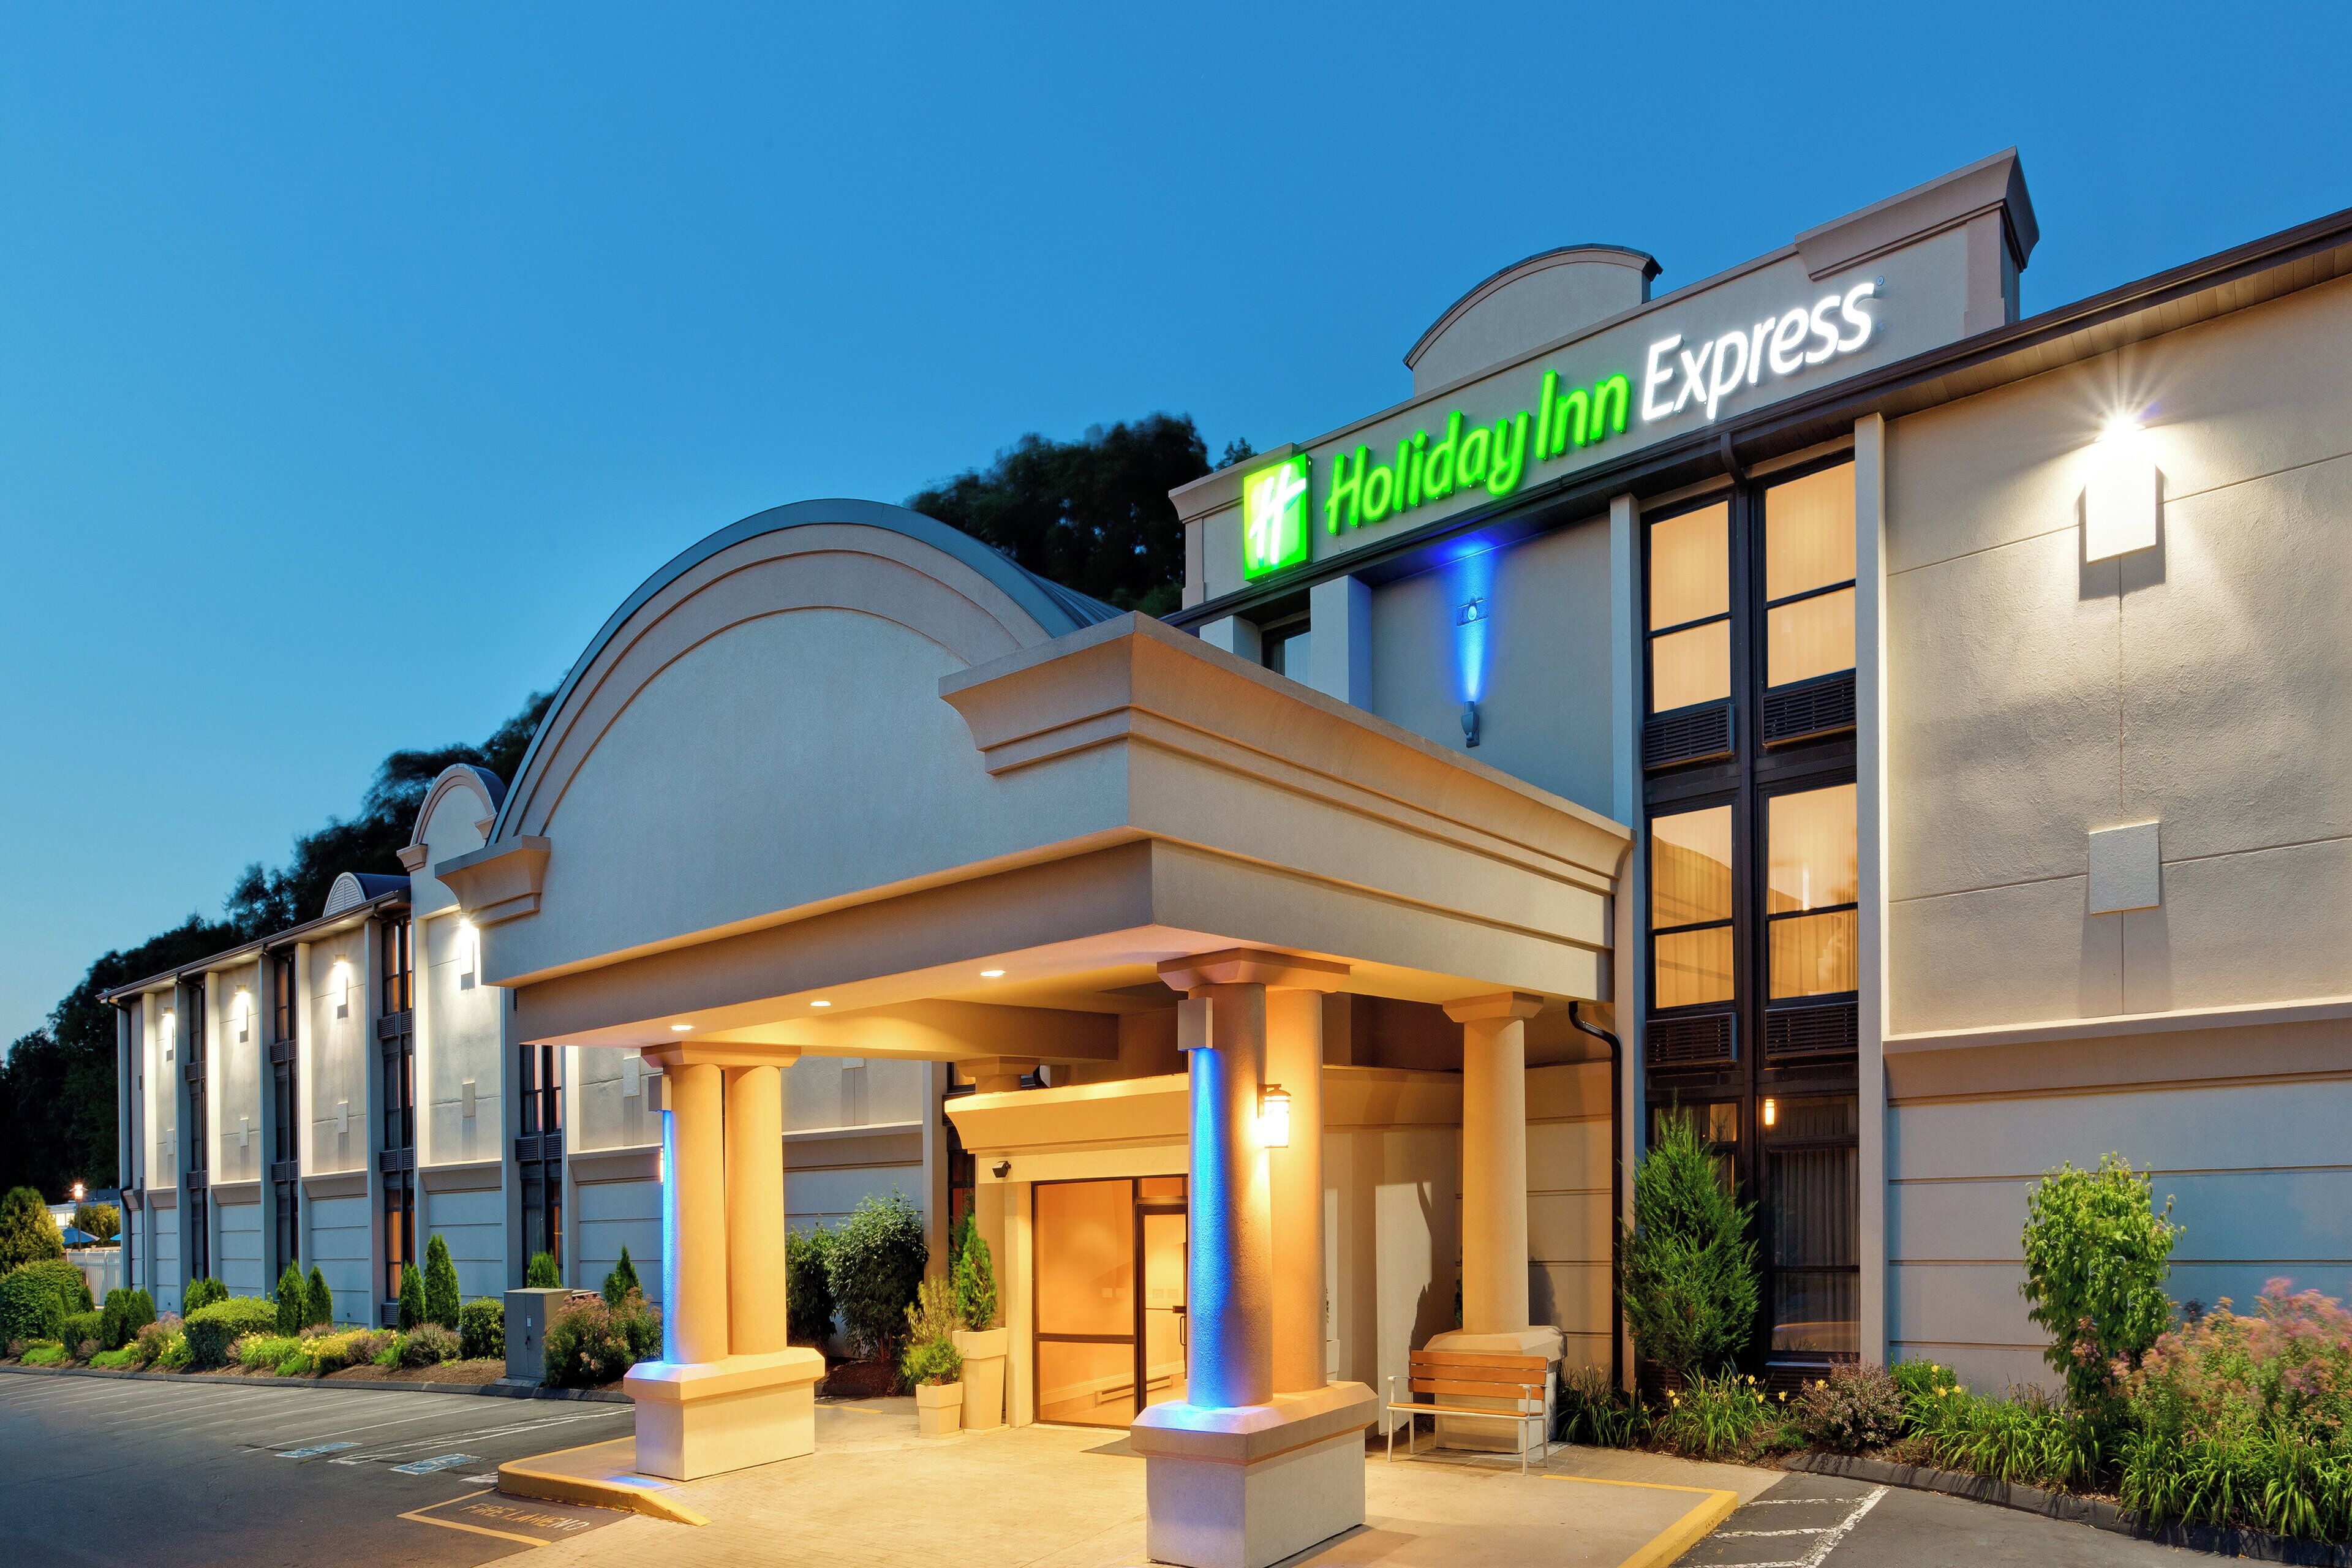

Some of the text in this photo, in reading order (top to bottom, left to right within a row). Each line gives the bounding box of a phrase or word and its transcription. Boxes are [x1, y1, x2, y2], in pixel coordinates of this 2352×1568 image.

[1324, 411, 1531, 535] Holiday
[1535, 369, 1631, 461] Inn
[1642, 282, 1876, 421] Express
[459, 1502, 517, 1517] FIRE
[500, 1510, 567, 1527] LANE
